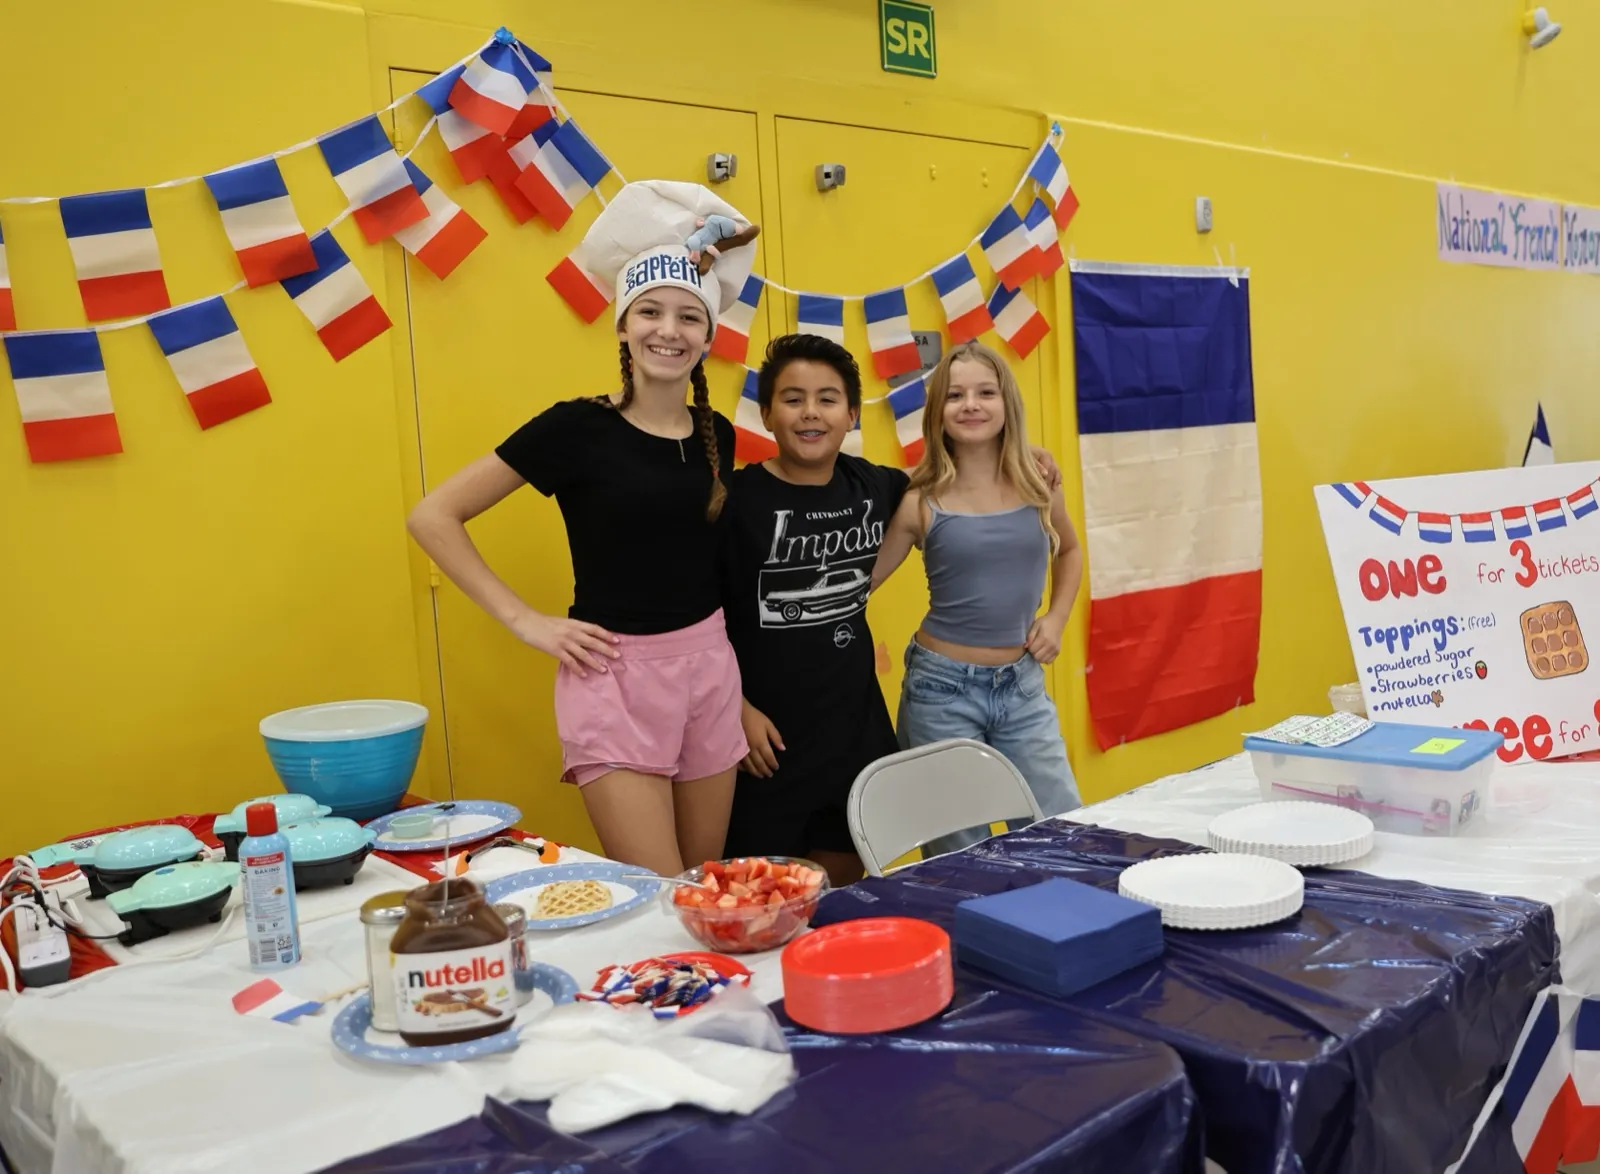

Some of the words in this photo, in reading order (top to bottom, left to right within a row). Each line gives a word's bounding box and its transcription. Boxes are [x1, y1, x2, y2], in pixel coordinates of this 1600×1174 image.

[887, 18, 930, 59] SR
[1438, 192, 1508, 256] National
[1509, 202, 1558, 264] French
[805, 508, 853, 520] CHEVROLET
[764, 499, 885, 572] Impala
[1477, 563, 1505, 583] for
[1509, 540, 1537, 587] 3
[1537, 552, 1600, 579] tickets
[1358, 615, 1466, 654] Toppings:
[1374, 649, 1431, 679] powdered
[1380, 693, 1434, 711] nutella
[1559, 720, 1591, 744] for
[409, 956, 505, 989] nutella
